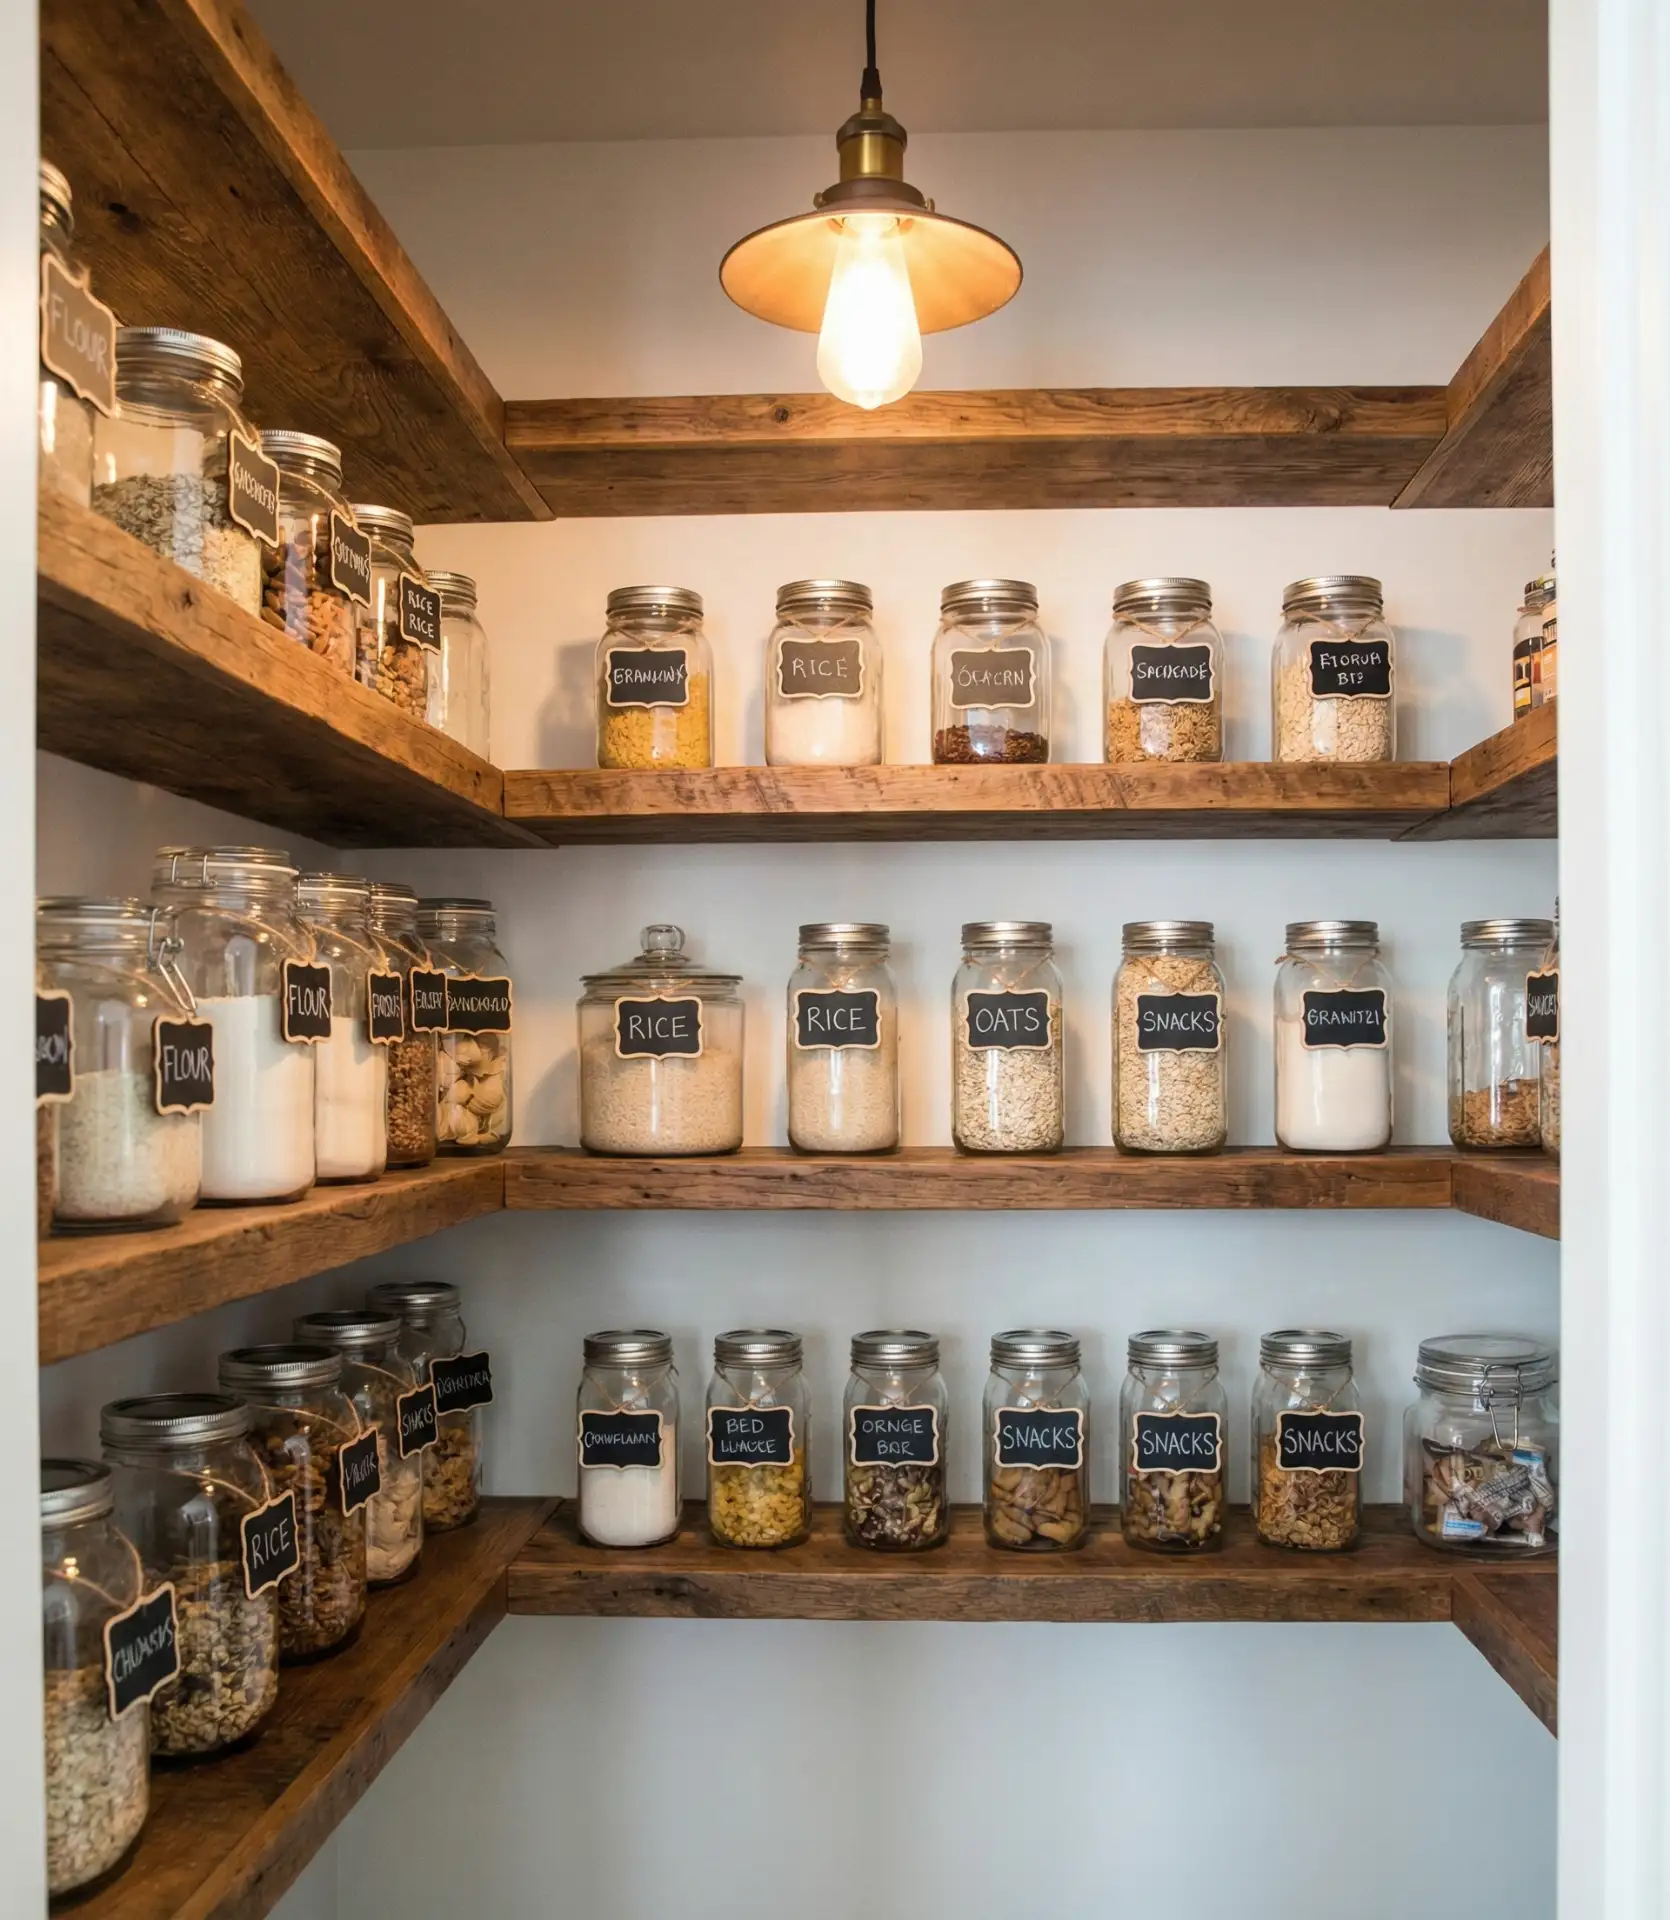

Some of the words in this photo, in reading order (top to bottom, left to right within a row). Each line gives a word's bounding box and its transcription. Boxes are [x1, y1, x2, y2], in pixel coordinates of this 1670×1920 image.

[49, 296, 110, 378] FLOUR
[407, 589, 435, 616] RICE
[408, 613, 435, 639] RICE
[791, 657, 849, 679] RICE
[288, 983, 330, 1019] FLOUR
[628, 1014, 689, 1040] RICE
[806, 1006, 867, 1032] RICE
[974, 1007, 1041, 1033] OATS
[1142, 1010, 1216, 1033] SNACKS
[163, 1044, 212, 1084] FLOUR
[726, 1418, 765, 1435] BED
[861, 1418, 924, 1435] ORNGE
[1002, 1425, 1076, 1450] SNACKS
[1141, 1428, 1215, 1456] SNACKS
[1283, 1427, 1358, 1455] SNACKS
[250, 1517, 291, 1570] RICE
